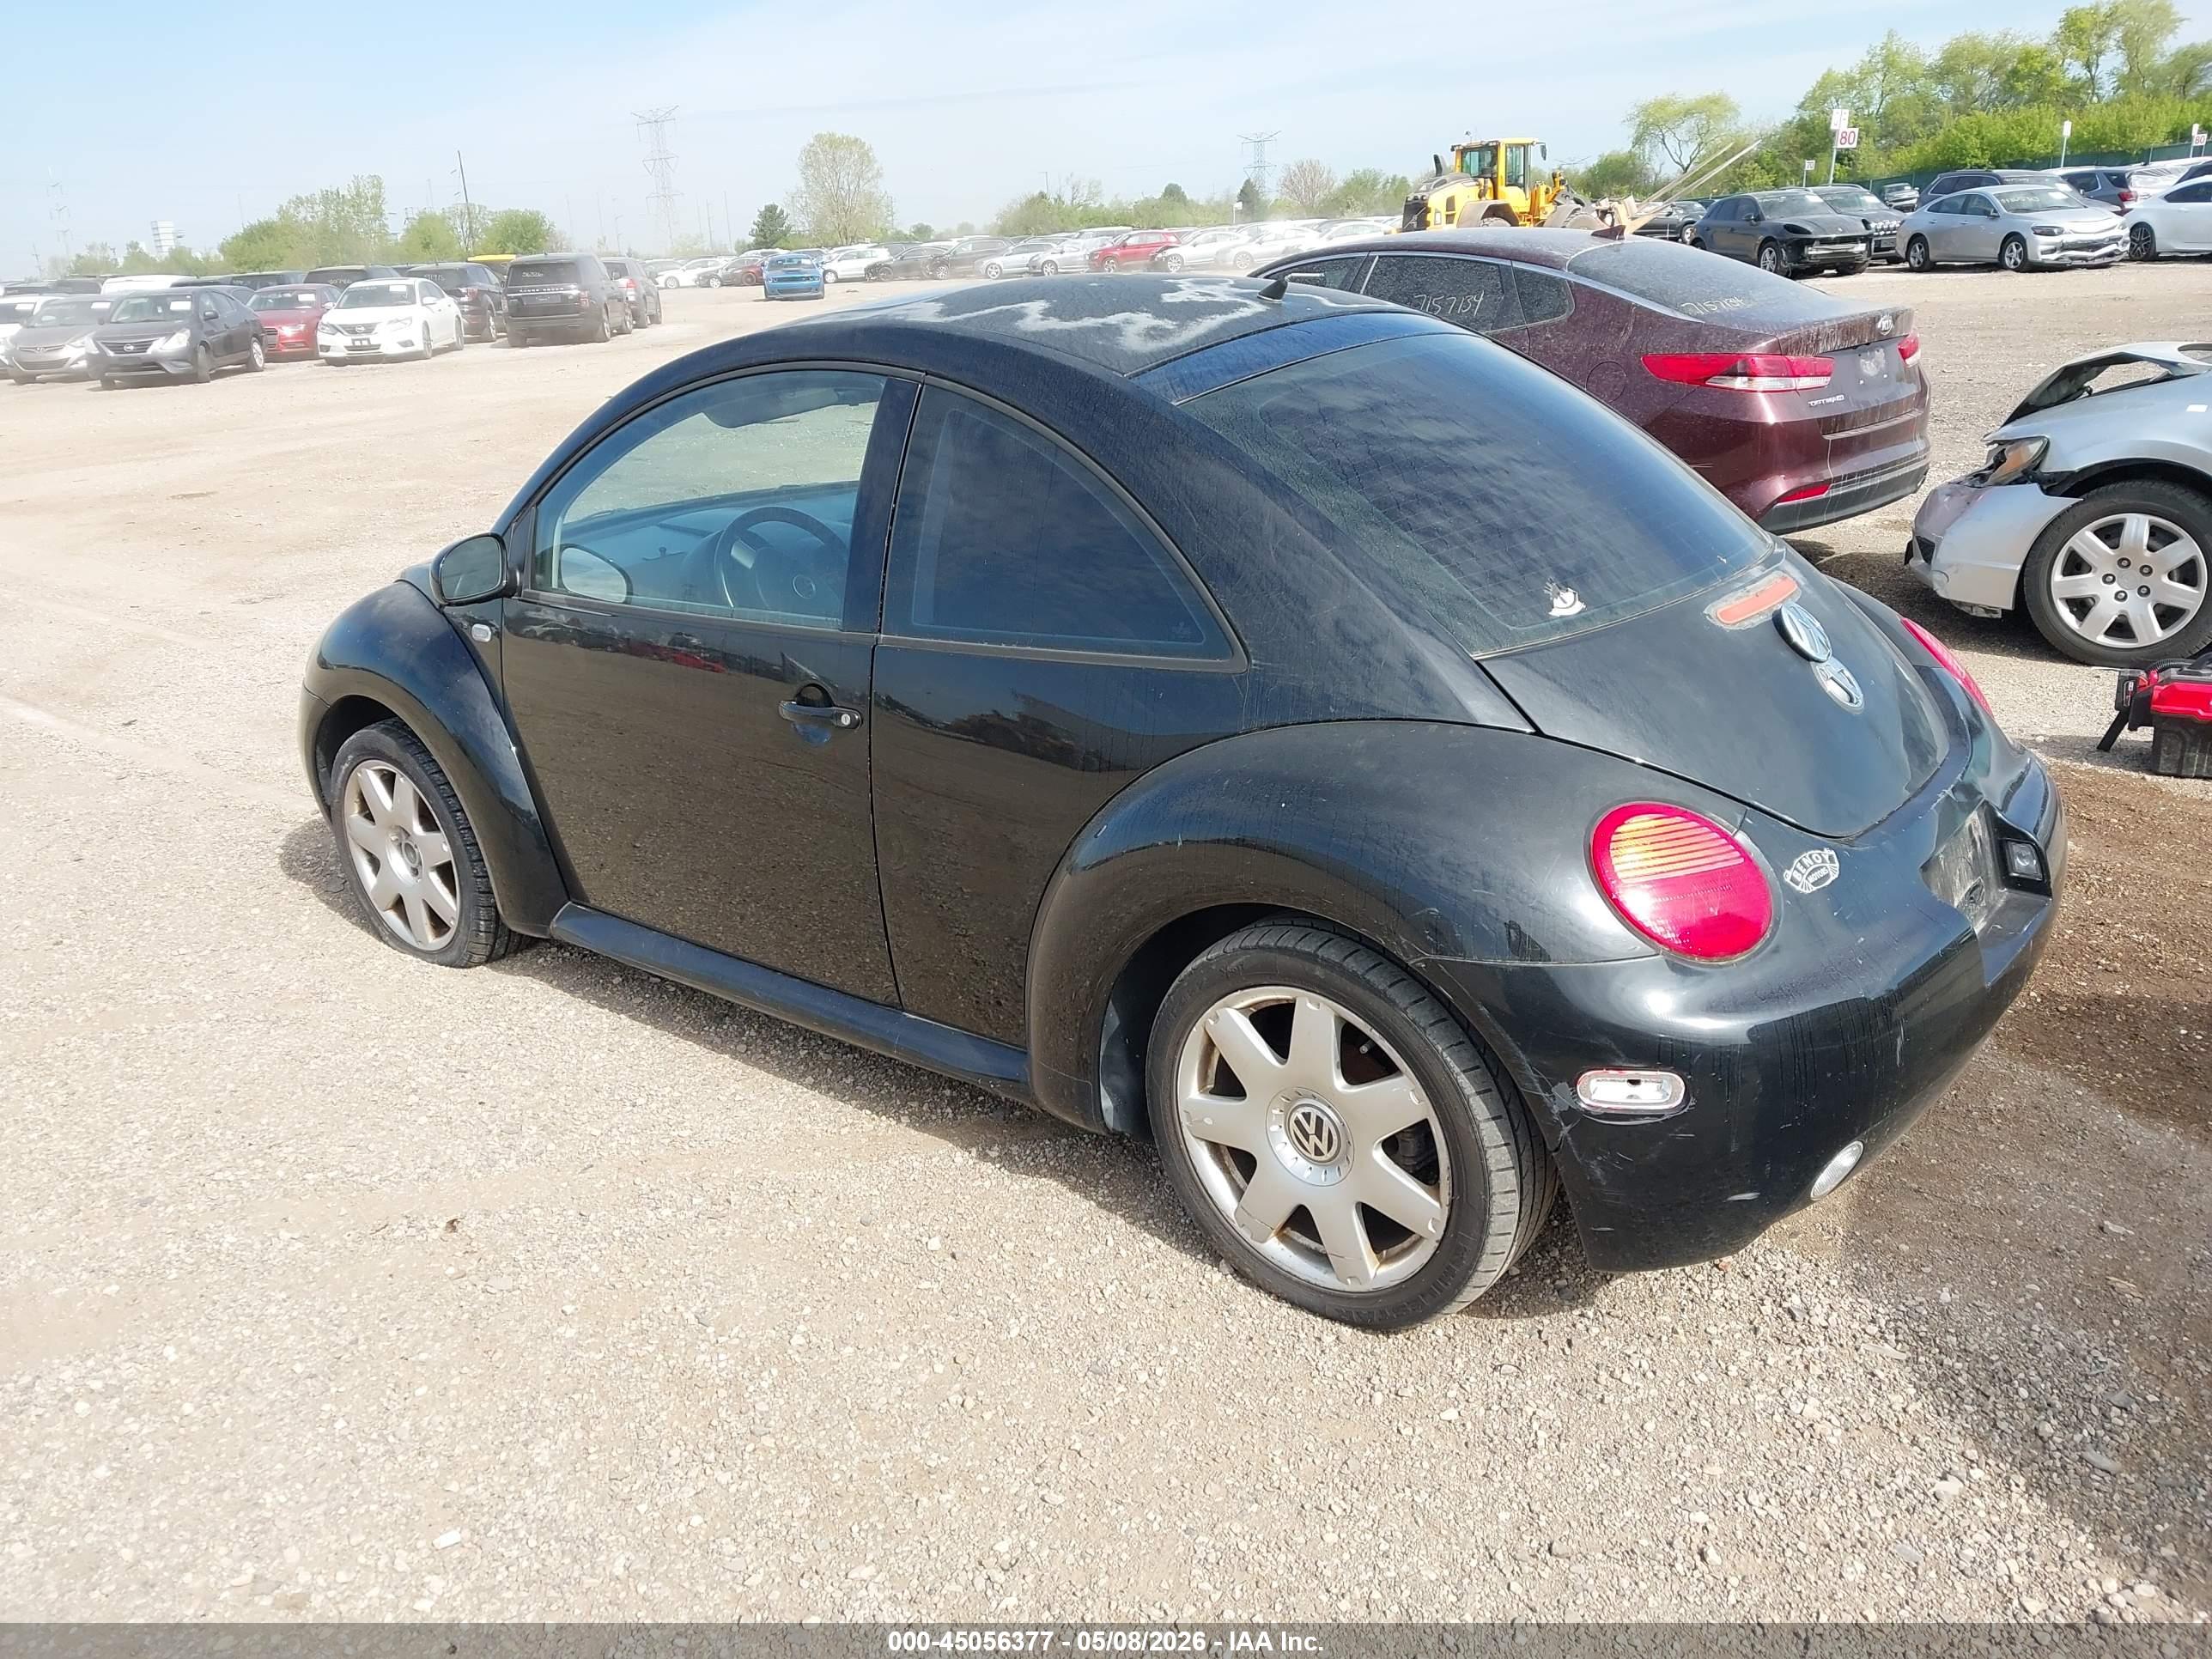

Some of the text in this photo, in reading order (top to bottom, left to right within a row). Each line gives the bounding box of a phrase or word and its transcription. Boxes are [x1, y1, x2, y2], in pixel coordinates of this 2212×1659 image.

[1839, 131, 1856, 145] 80
[2195, 136, 2206, 144] 80
[1413, 289, 1485, 317] 7157134
[1792, 853, 1831, 882] BENOY
[1289, 1105, 1340, 1161] VW
